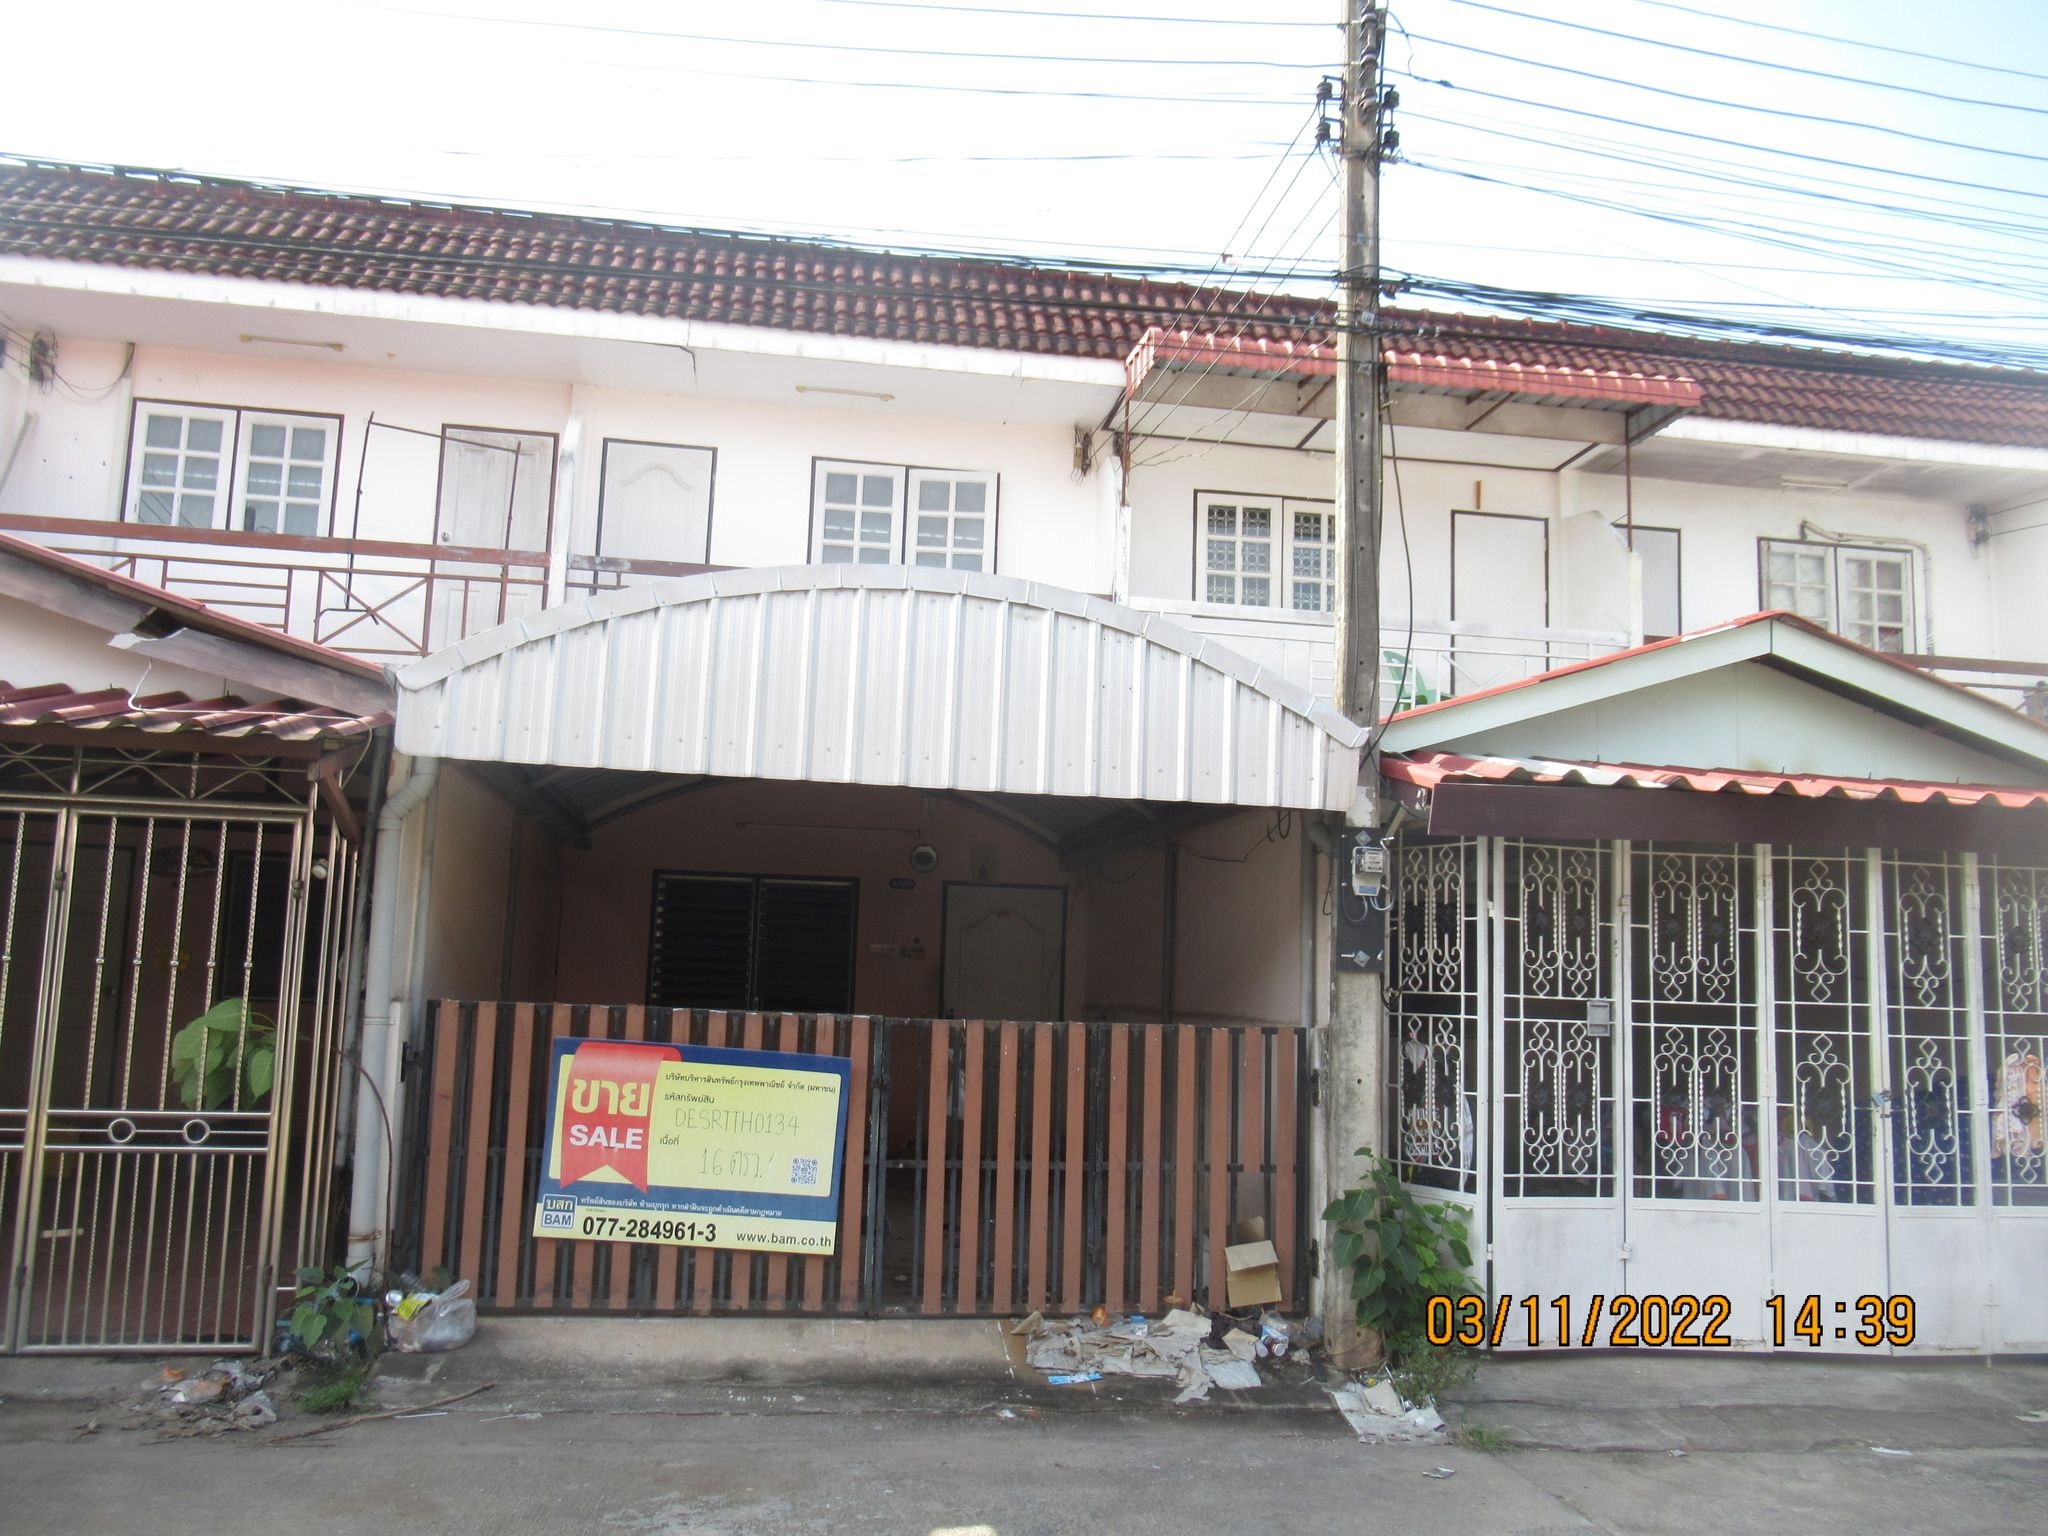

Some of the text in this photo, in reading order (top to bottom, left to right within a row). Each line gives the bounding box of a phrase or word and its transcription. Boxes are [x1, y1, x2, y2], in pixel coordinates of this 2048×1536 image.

[787, 1081, 805, 1091] จำกัด
[808, 1084, 837, 1095] (มหาชน)
[571, 1078, 651, 1118] ขาย
[664, 1092, 716, 1105] รหัสทรัพย์สิน
[569, 1124, 644, 1150] SALE
[659, 1133, 681, 1146] เนื้อที่
[699, 1148, 723, 1176] 16
[546, 1197, 574, 1212] บสก
[544, 1213, 572, 1227] BAM
[582, 1214, 717, 1244] 077-284961-3
[736, 1230, 833, 1249] www.bam.co.th
